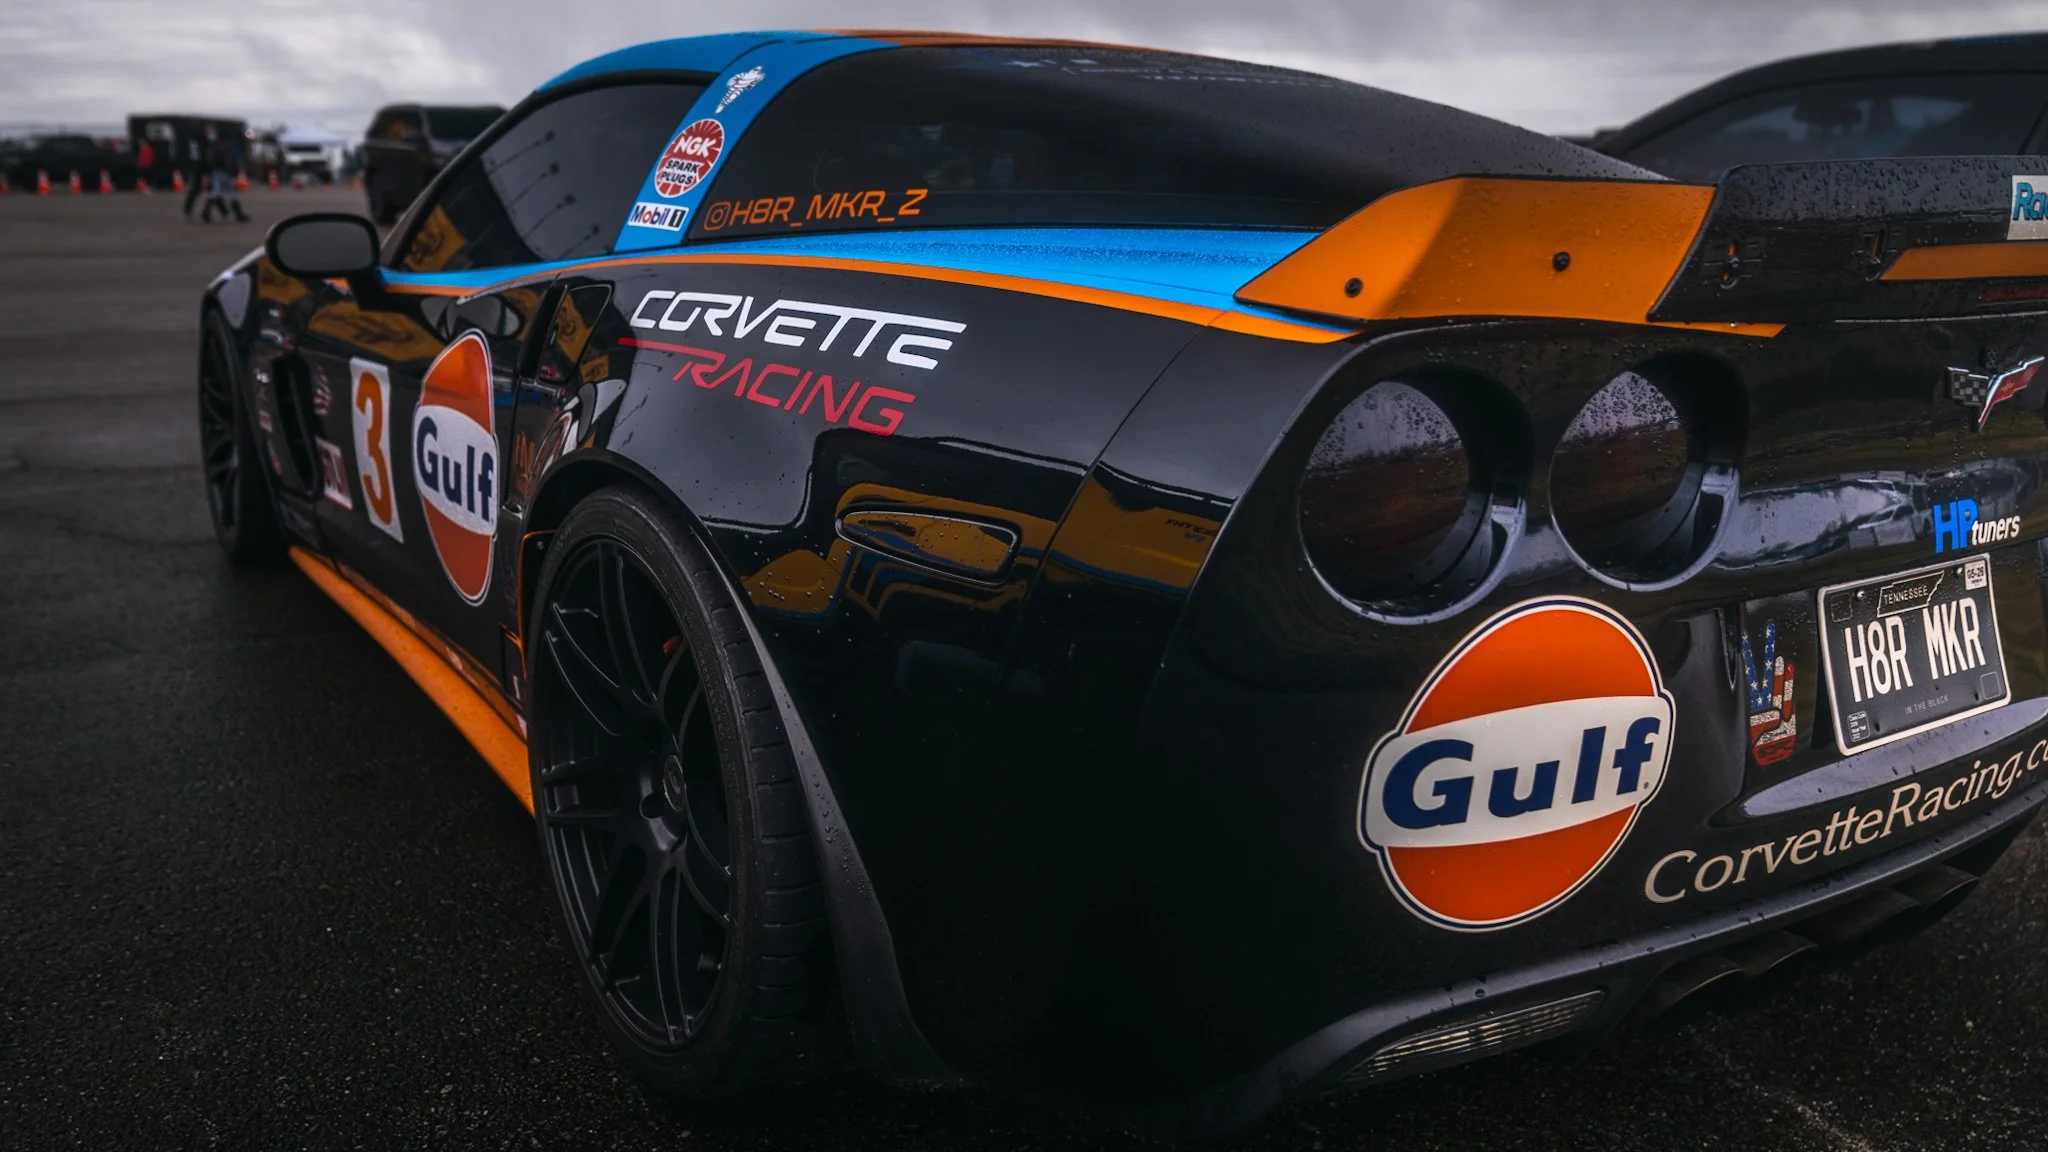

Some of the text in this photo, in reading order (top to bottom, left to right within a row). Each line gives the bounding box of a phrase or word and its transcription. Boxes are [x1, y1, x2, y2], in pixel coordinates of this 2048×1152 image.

[661, 171, 694, 185] PLUGS
[665, 159, 700, 174] SPARK
[673, 136, 717, 158] NGK
[630, 205, 671, 226] Mobil
[2012, 182, 2048, 221] Ra
[629, 289, 968, 371] CORVETTE
[617, 336, 916, 437] RACING
[356, 371, 393, 527] 3
[415, 416, 494, 525] Gulf
[1933, 498, 2021, 553] HP tuners
[1883, 584, 1929, 605] TENNESSEE
[1844, 597, 1987, 703] H8R MKR
[1382, 716, 1662, 830] Gulf
[1643, 739, 2048, 904] CorvetteRacing.c
